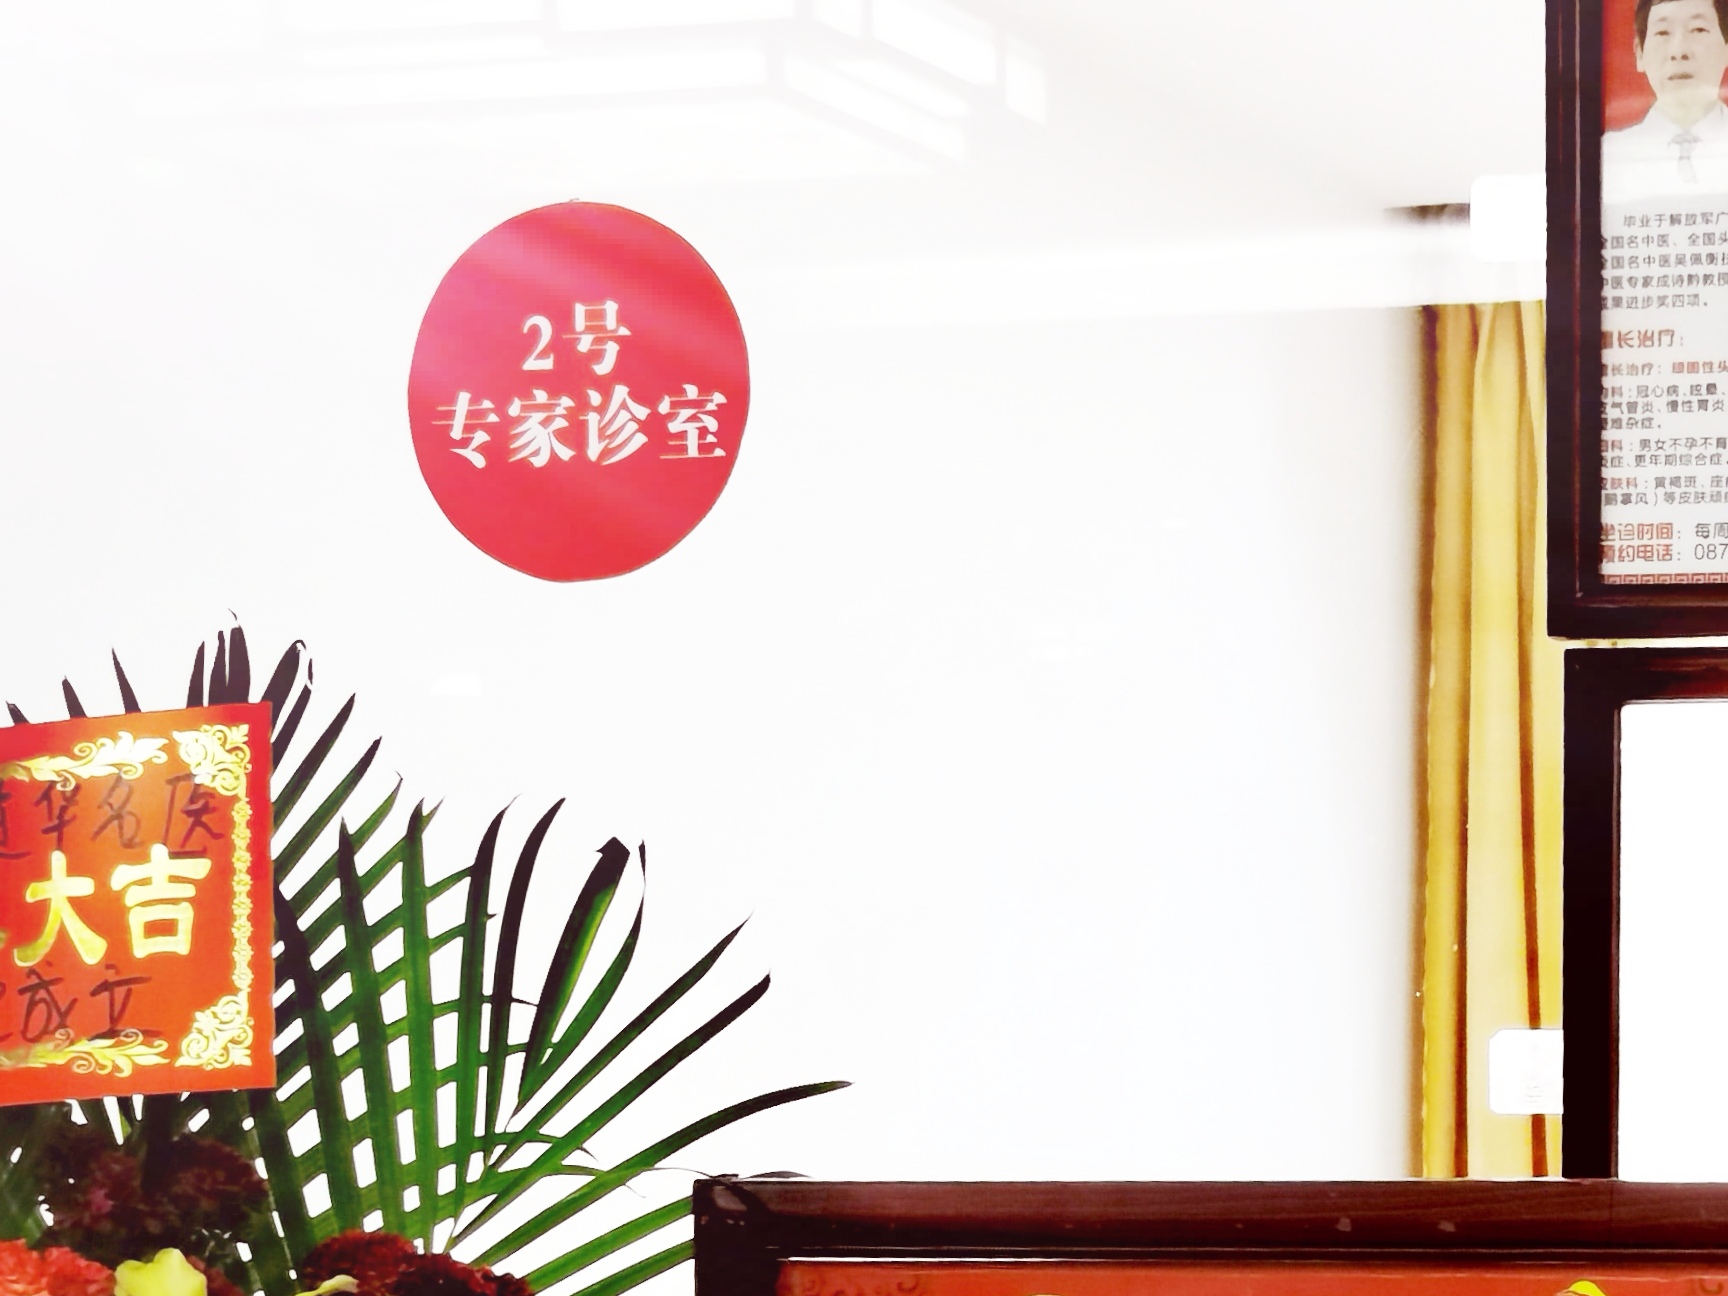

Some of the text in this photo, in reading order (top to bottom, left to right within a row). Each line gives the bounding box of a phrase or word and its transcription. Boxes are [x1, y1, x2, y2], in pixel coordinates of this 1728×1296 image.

[522, 300, 631, 376] 2号
[431, 384, 728, 469] 专家诊室
[0, 769, 226, 860] 华名医
[14, 843, 212, 967] 大吉
[0, 960, 162, 1044] 成立
